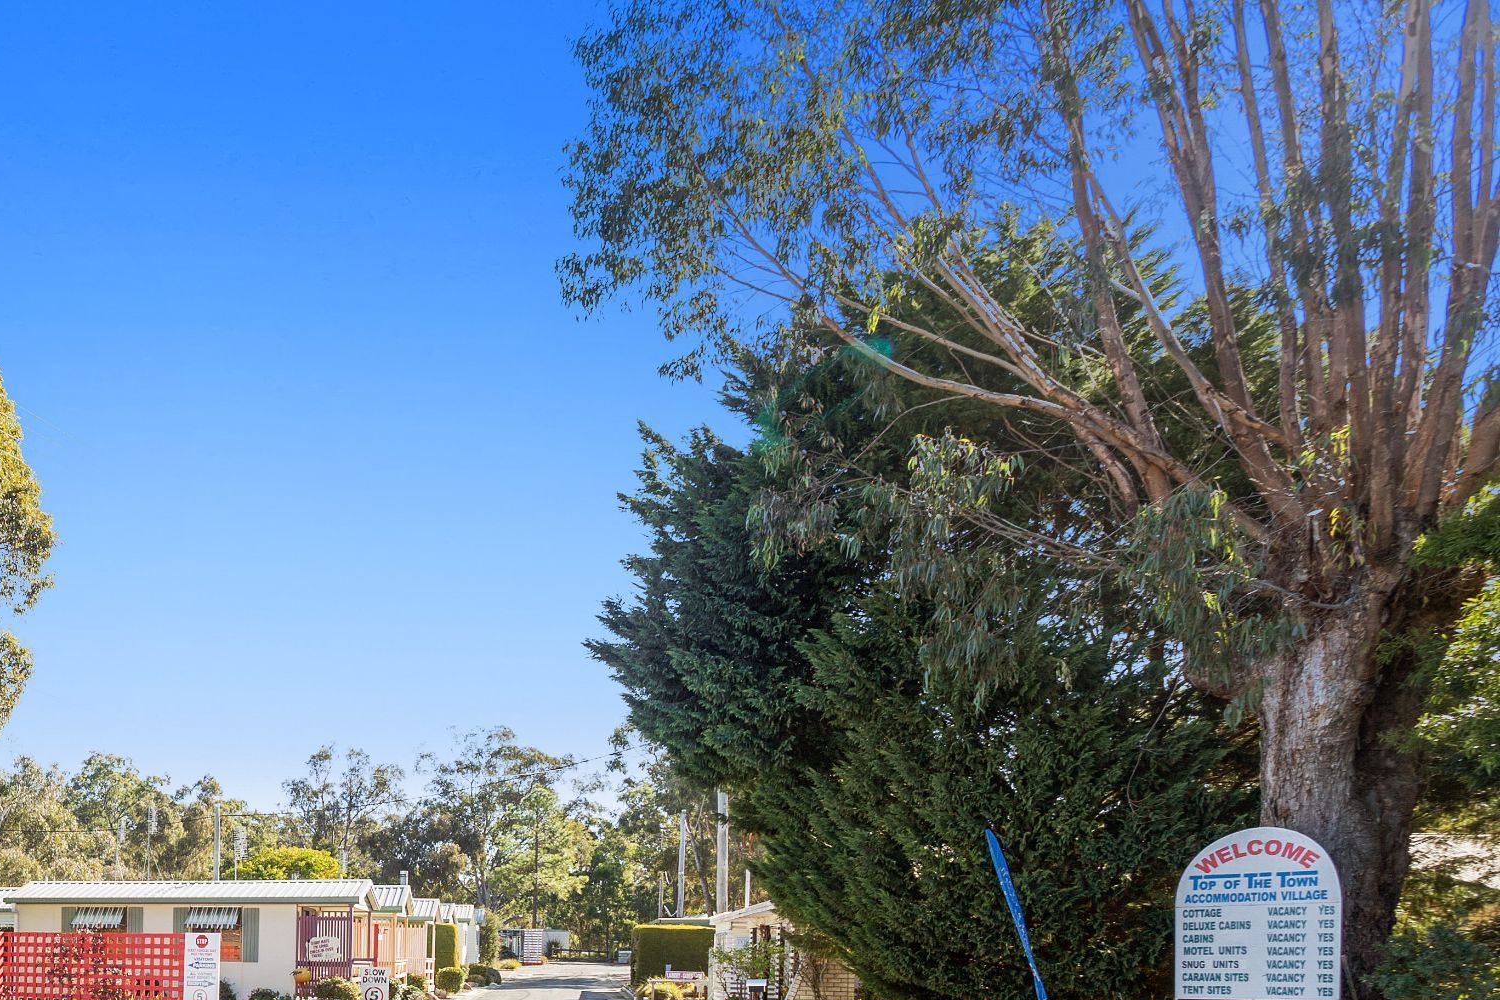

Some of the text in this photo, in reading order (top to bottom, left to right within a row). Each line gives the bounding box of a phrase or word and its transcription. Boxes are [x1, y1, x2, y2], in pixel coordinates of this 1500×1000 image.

[1194, 839, 1321, 874] WELCOME
[1189, 870, 1318, 891] TOP OF THE TOWN
[1184, 889, 1328, 904] ACCOMMODATION VILLAGE
[1183, 905, 1335, 919] COTTAGE VACANCY YES
[1183, 919, 1334, 931] DELUXE CABINS VACANCY YES
[1183, 933, 1334, 944] CABINS VACANCY YES
[1183, 945, 1334, 956] MOTEL UNITS VACANCY YES
[1181, 960, 1334, 970] SNUG UNITS VACANCY YES
[364, 968, 386, 976] SLOW
[1182, 972, 1333, 983] CARAVAN SITES VACANCY YES
[362, 976, 387, 984] DOWN
[369, 990, 379, 1000] 5
[1182, 985, 1333, 997] TENT SITES VACANCY YES
